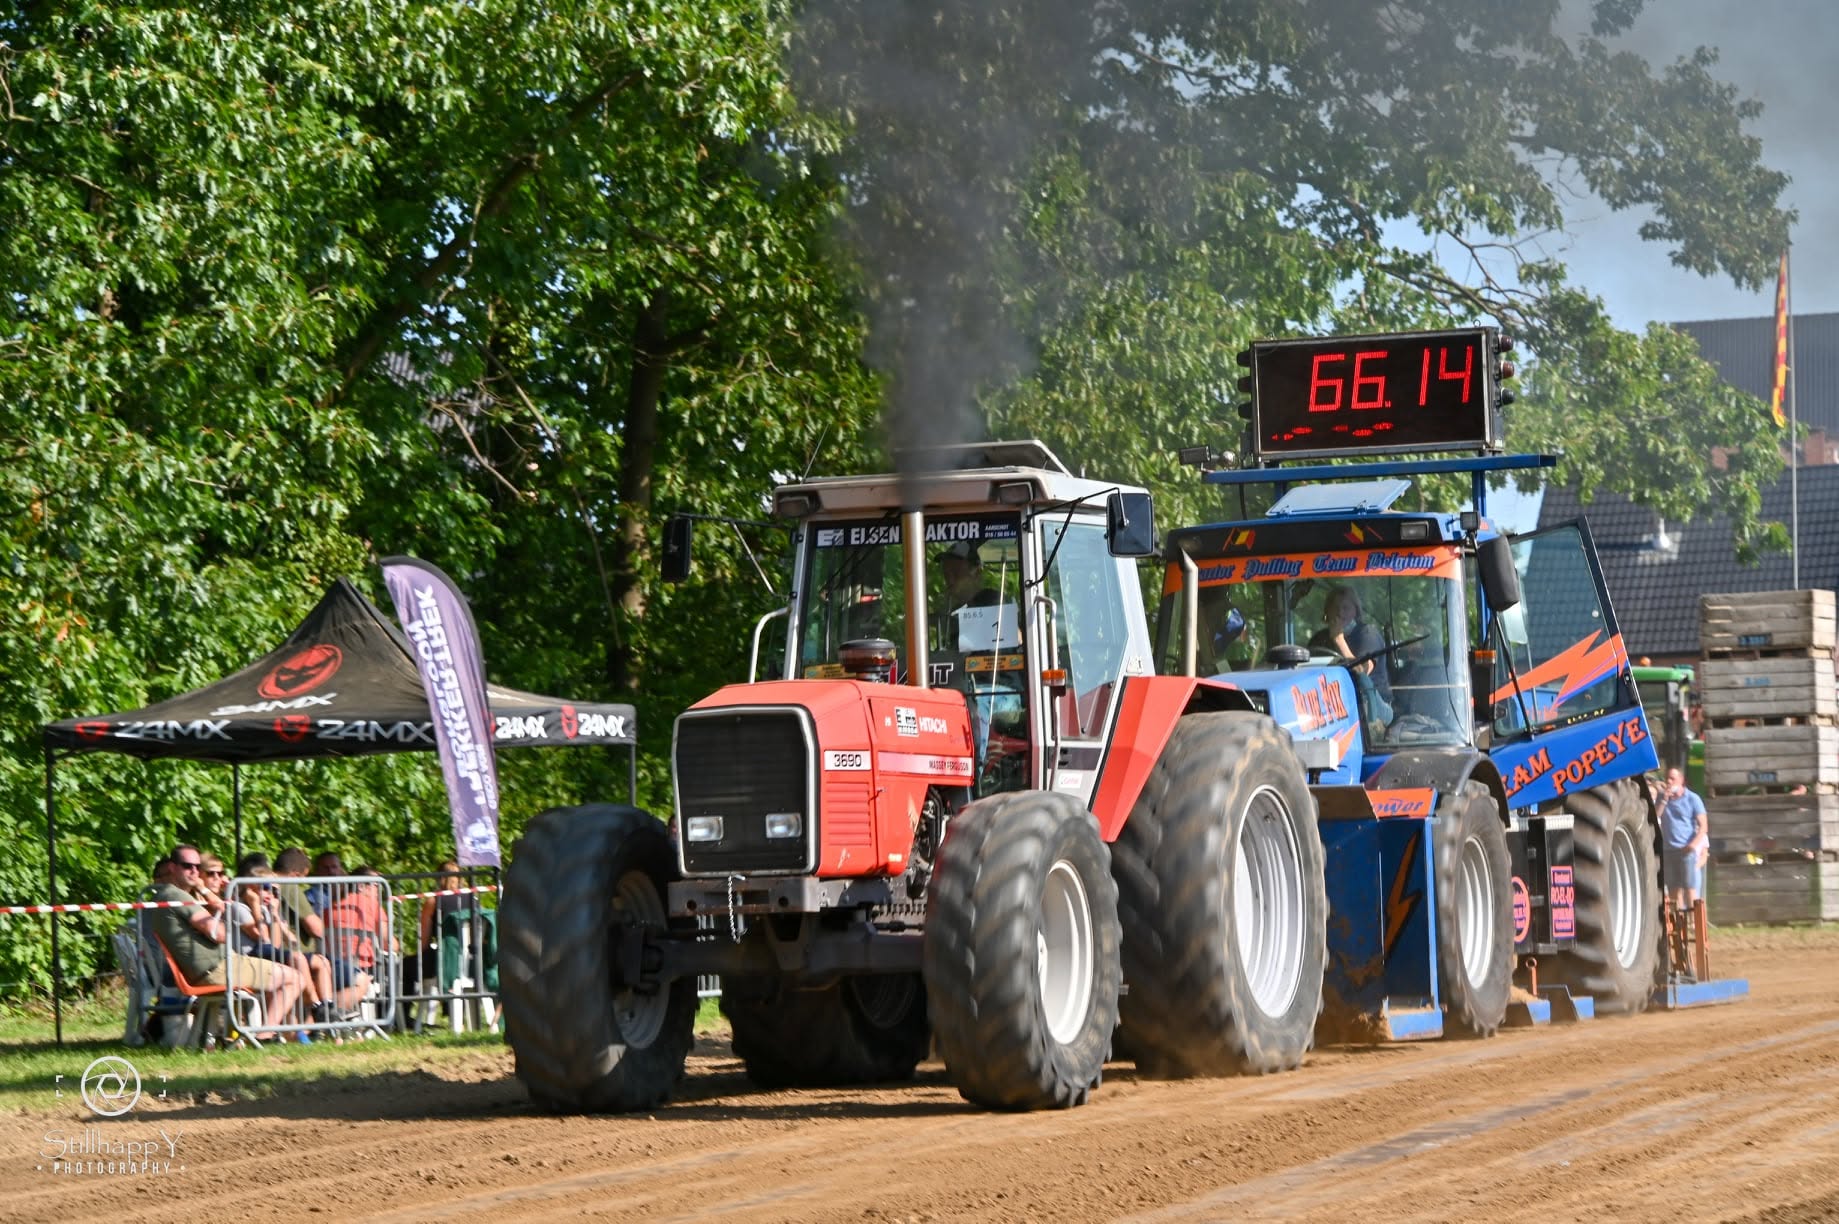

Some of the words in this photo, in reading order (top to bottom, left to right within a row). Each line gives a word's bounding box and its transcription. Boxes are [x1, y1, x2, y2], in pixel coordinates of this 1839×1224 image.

[850, 526, 900, 545] ELSEN
[926, 521, 980, 541] AKTOR
[1242, 558, 1303, 581] Pulling
[1313, 554, 1358, 573] Team
[1365, 552, 1435, 573] Belgium
[992, 620, 1005, 643] 1
[209, 692, 339, 717] 24MX
[114, 718, 233, 741] 24MX
[316, 718, 437, 743] 24MX
[495, 715, 548, 739] 24MX
[577, 713, 626, 738] 24MX
[834, 753, 862, 768] 3690
[928, 760, 946, 770] MASSEY
[1551, 716, 1648, 796] POPEYE
